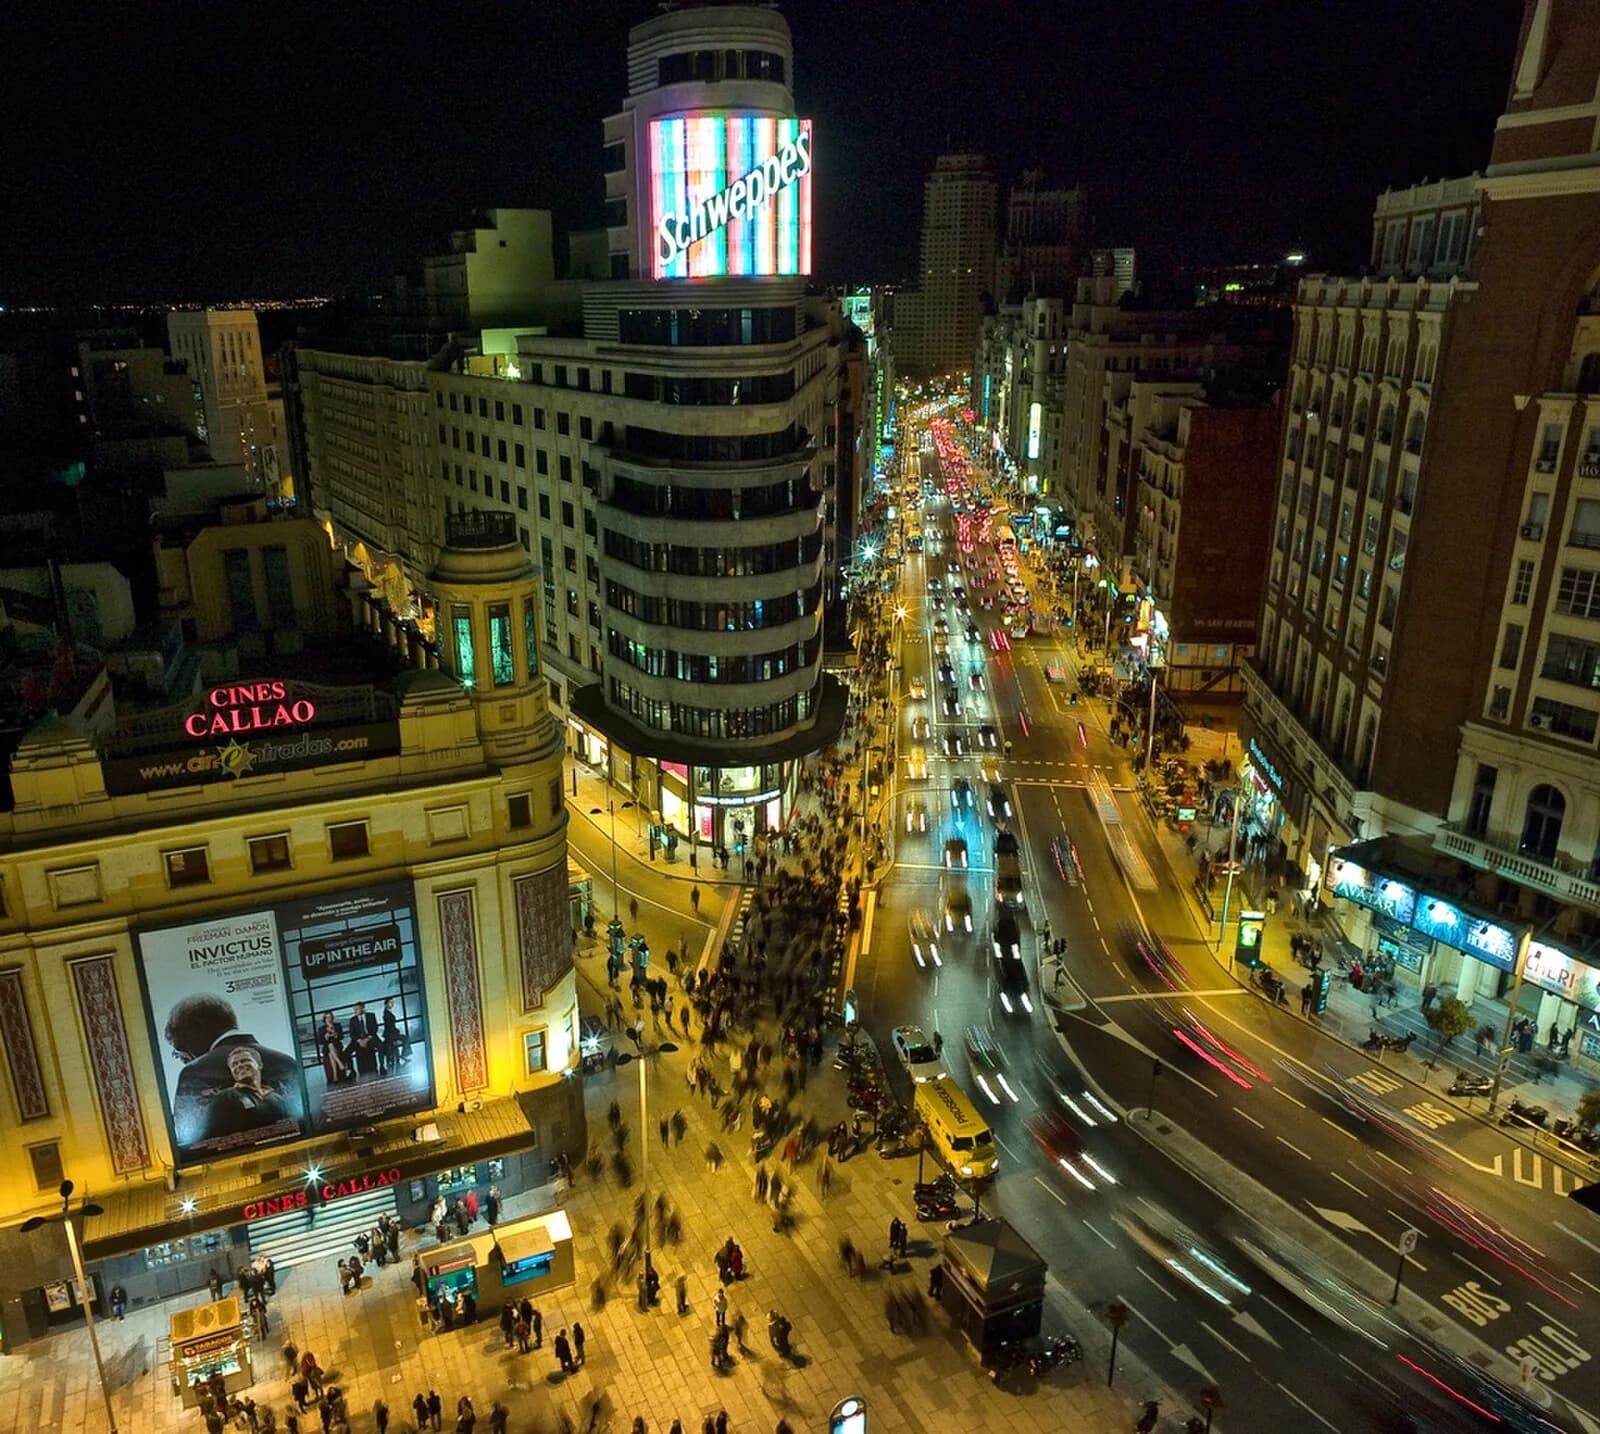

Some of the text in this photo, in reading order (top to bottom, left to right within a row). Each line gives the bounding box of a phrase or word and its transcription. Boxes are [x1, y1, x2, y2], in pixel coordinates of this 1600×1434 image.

[656, 130, 810, 266] Schweppes
[210, 681, 286, 707] CINES
[185, 700, 315, 737] CALLAO
[1339, 880, 1394, 917] AVATAR
[235, 923, 270, 935] DAMON
[188, 936, 272, 962] INVICTUS
[203, 955, 236, 967] FACTOR
[236, 949, 273, 961] HUMANO
[305, 953, 326, 966] UP
[327, 950, 341, 962] IN
[342, 943, 371, 959] THE
[372, 938, 397, 953] AIR
[225, 981, 236, 993] 3
[1402, 1102, 1456, 1129] BUS
[322, 1168, 401, 1199] CALLAO
[243, 1191, 308, 1220] CINES
[1441, 1280, 1511, 1327] BUS
[1505, 1325, 1592, 1381] SOLO
